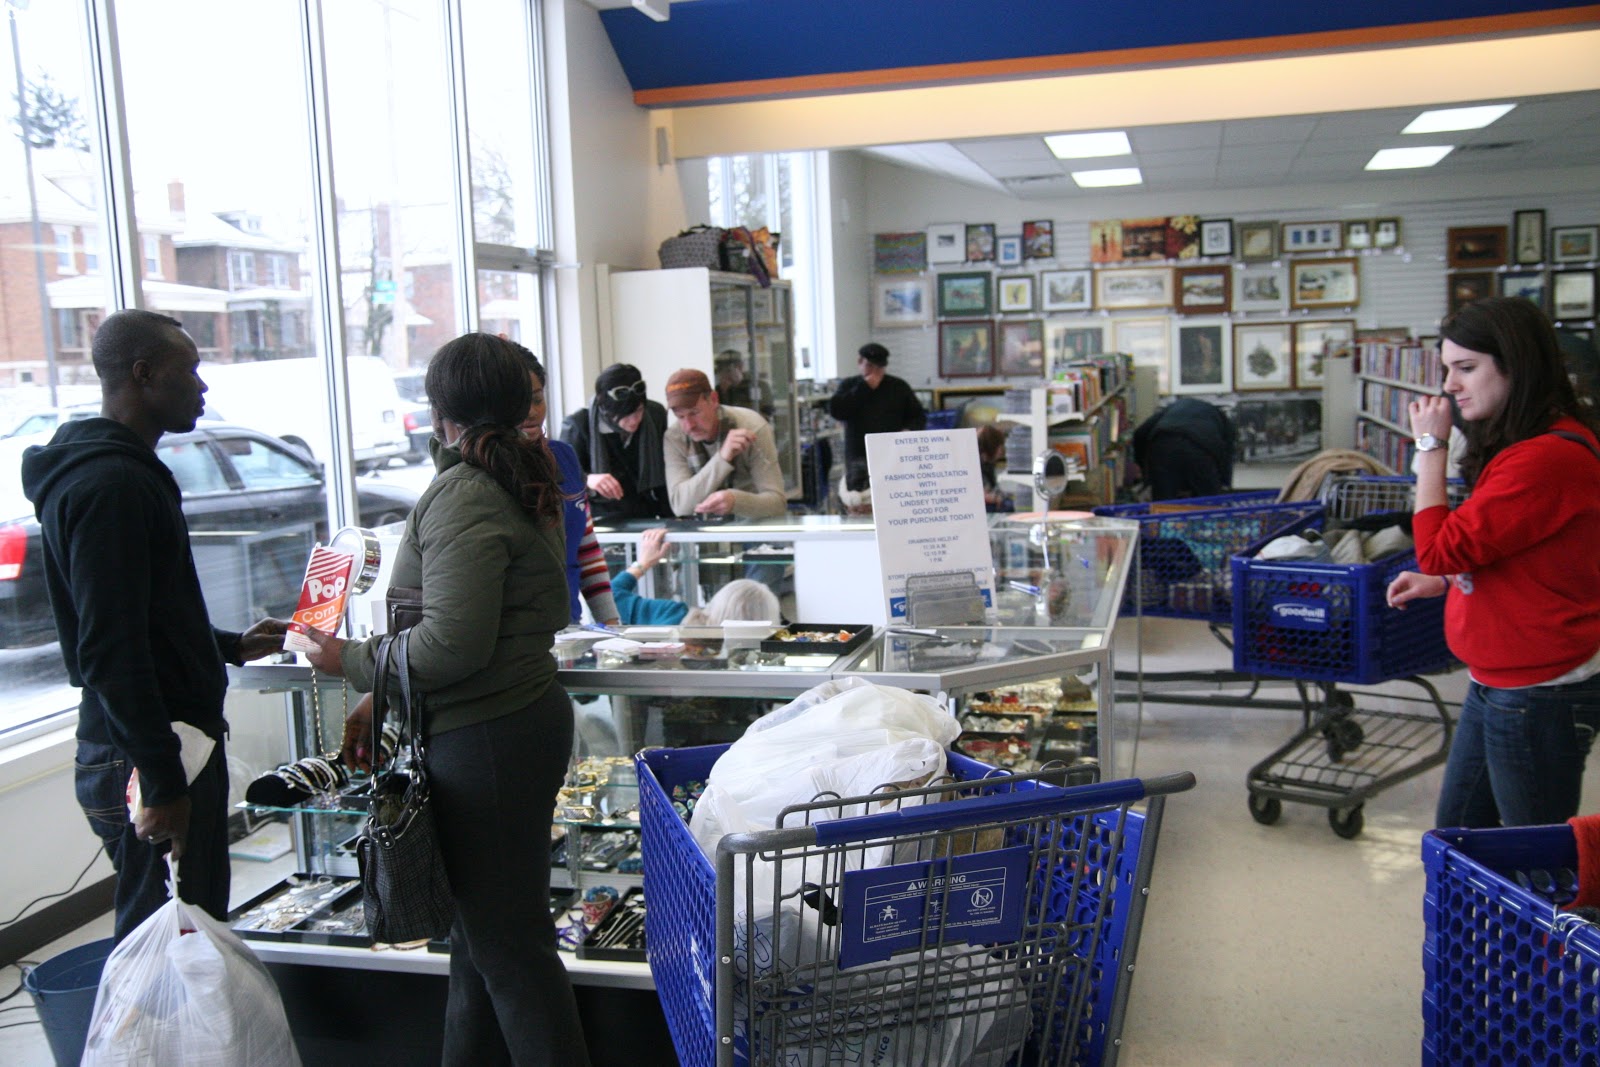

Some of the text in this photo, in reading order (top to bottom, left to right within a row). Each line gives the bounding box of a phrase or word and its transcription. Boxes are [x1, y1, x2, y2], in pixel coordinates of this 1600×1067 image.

[899, 454, 923, 462] STORE
[884, 470, 968, 481] FASHION CONSULTATION
[889, 487, 967, 499] LOCAL THRIFT EXPERT
[900, 499, 929, 507] LINDSEY
[888, 517, 908, 526] YOUR
[910, 515, 948, 524] PURCHASE
[308, 577, 346, 603] Pop
[302, 605, 335, 623] Corn
[1280, 606, 1325, 618] goodwill
